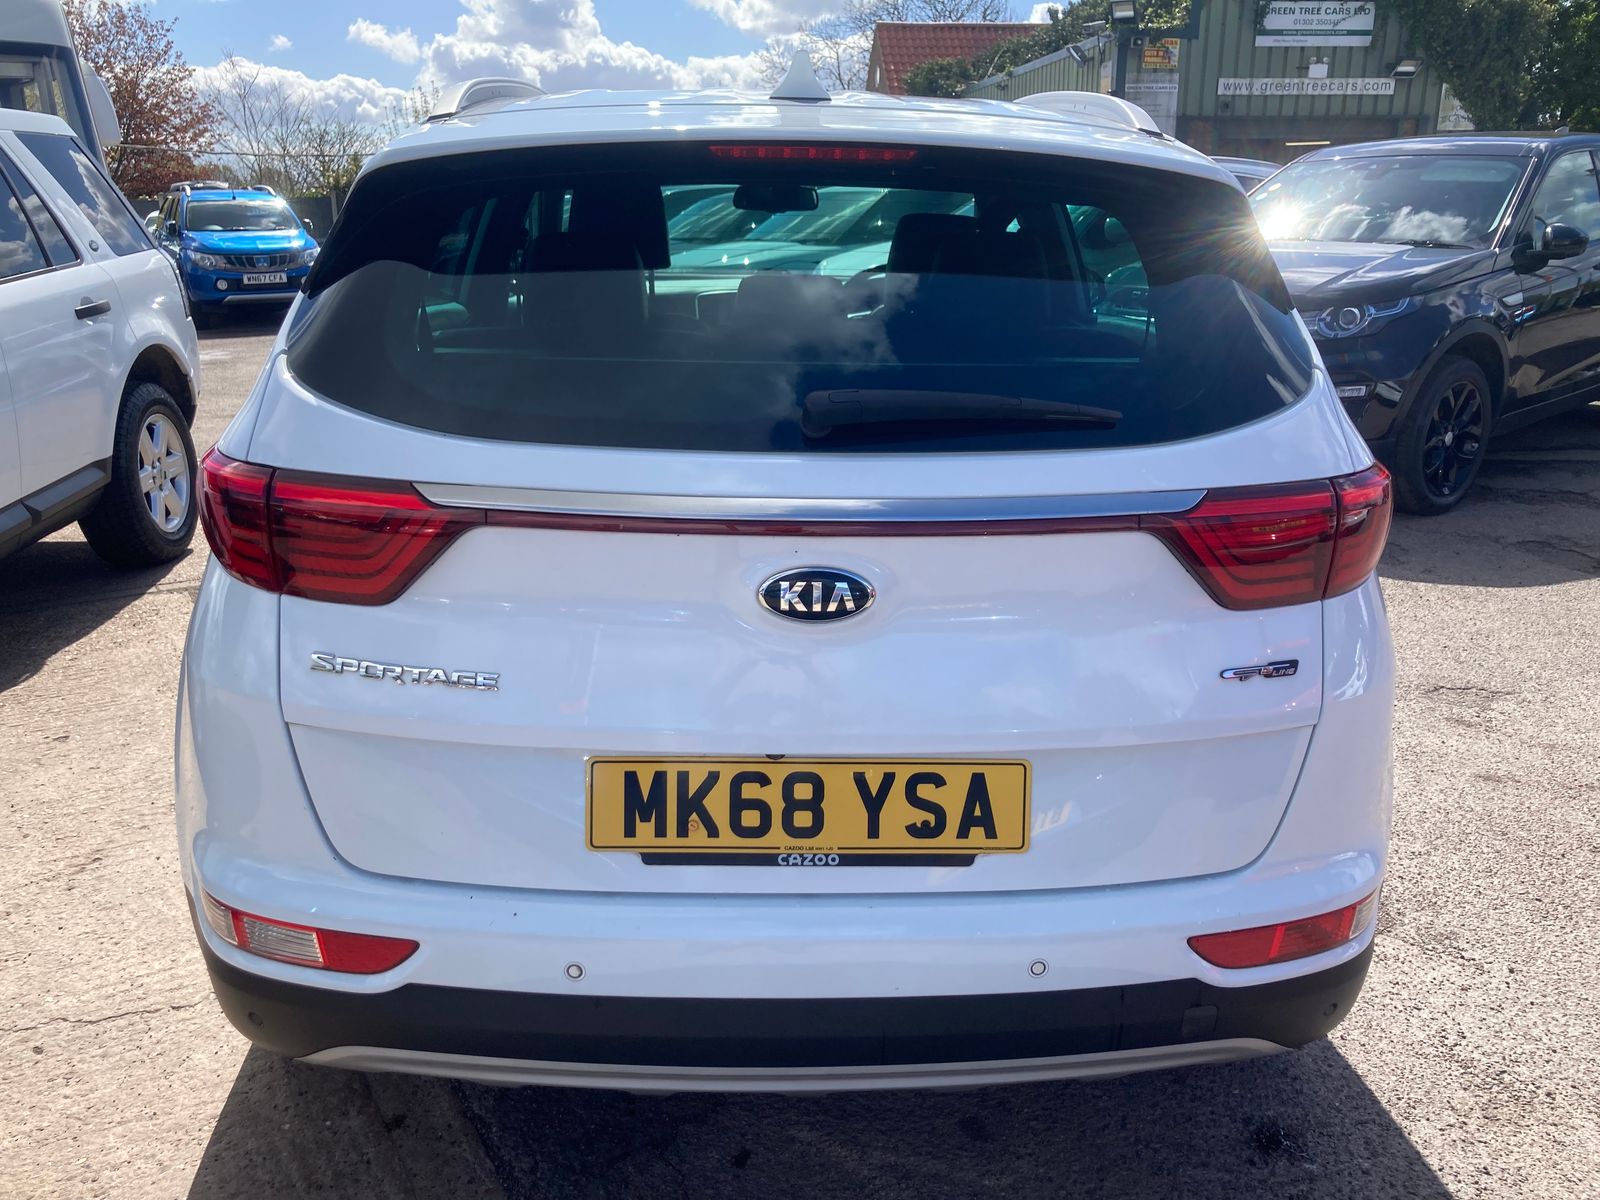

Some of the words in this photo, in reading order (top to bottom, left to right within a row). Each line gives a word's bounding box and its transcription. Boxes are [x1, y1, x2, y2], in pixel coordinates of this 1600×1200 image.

[1299, 7, 1321, 15] TREE
[1324, 7, 1351, 15] CARS
[1223, 80, 1391, 94] www.greentreecars.com
[779, 581, 856, 612] KIA
[310, 652, 500, 691] SPORTAGE
[623, 770, 825, 839] MK68
[852, 771, 998, 840] YSA
[777, 853, 840, 866] CAZOO
